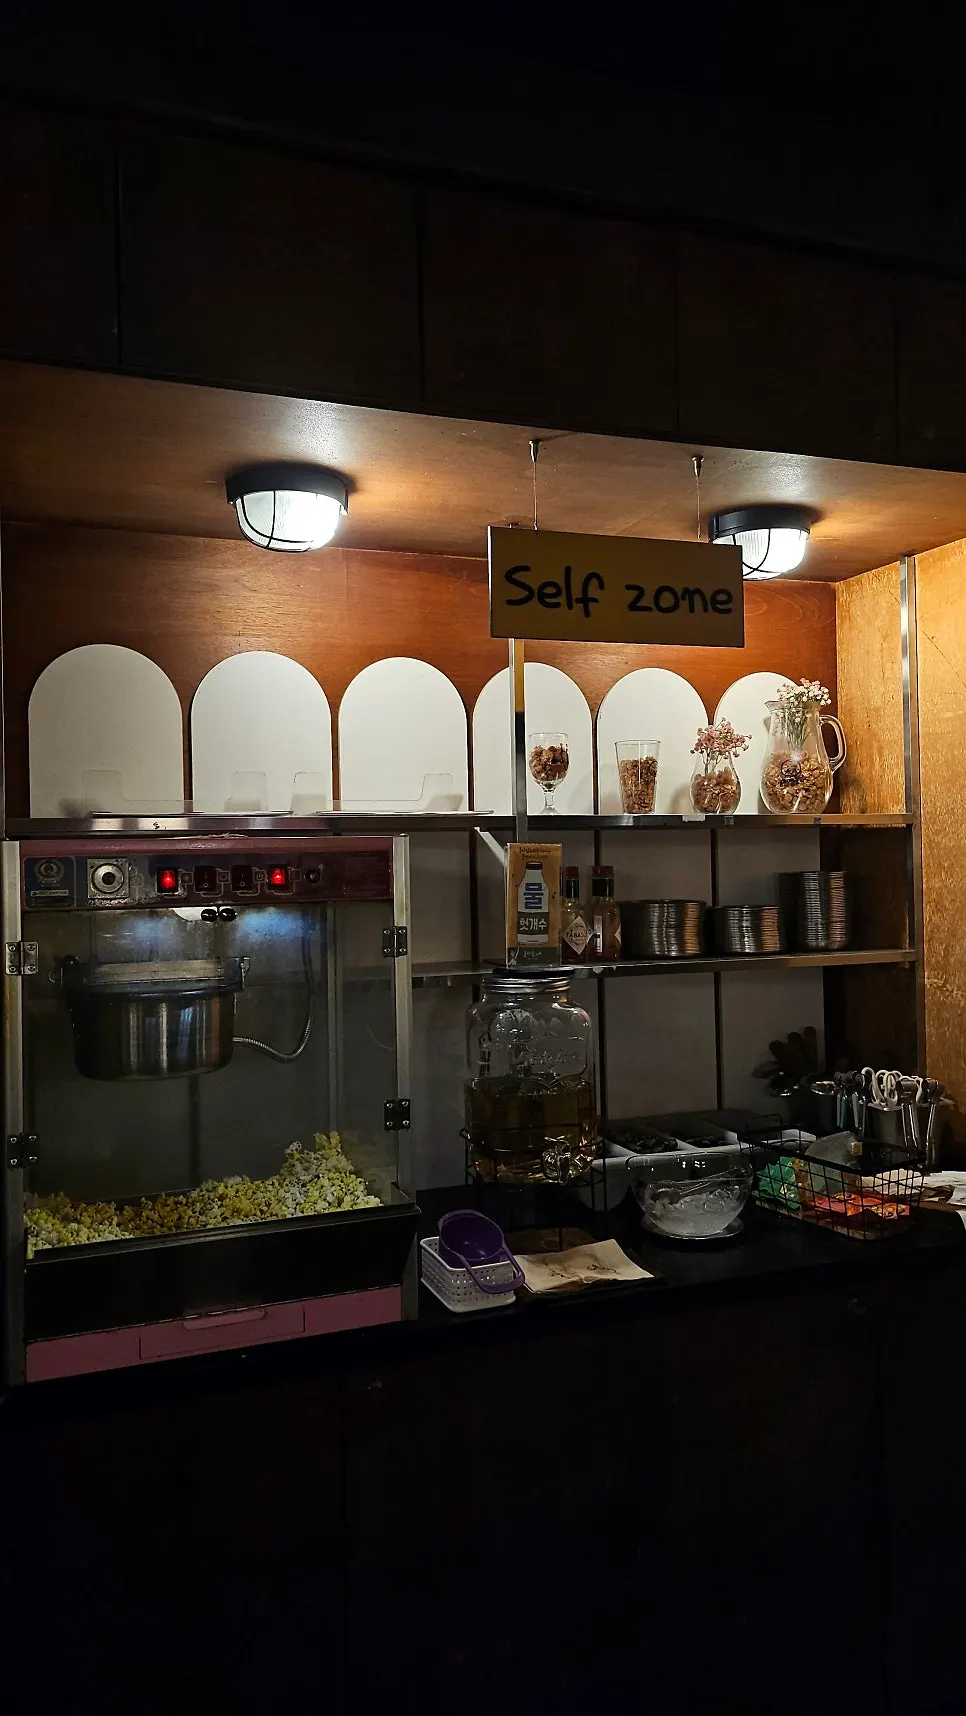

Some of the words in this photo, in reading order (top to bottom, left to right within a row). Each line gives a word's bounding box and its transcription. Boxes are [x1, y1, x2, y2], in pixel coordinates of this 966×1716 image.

[504, 565, 605, 618] Self
[625, 584, 733, 614] zone
[523, 883, 544, 909] 물
[519, 917, 548, 931] 헛개수
